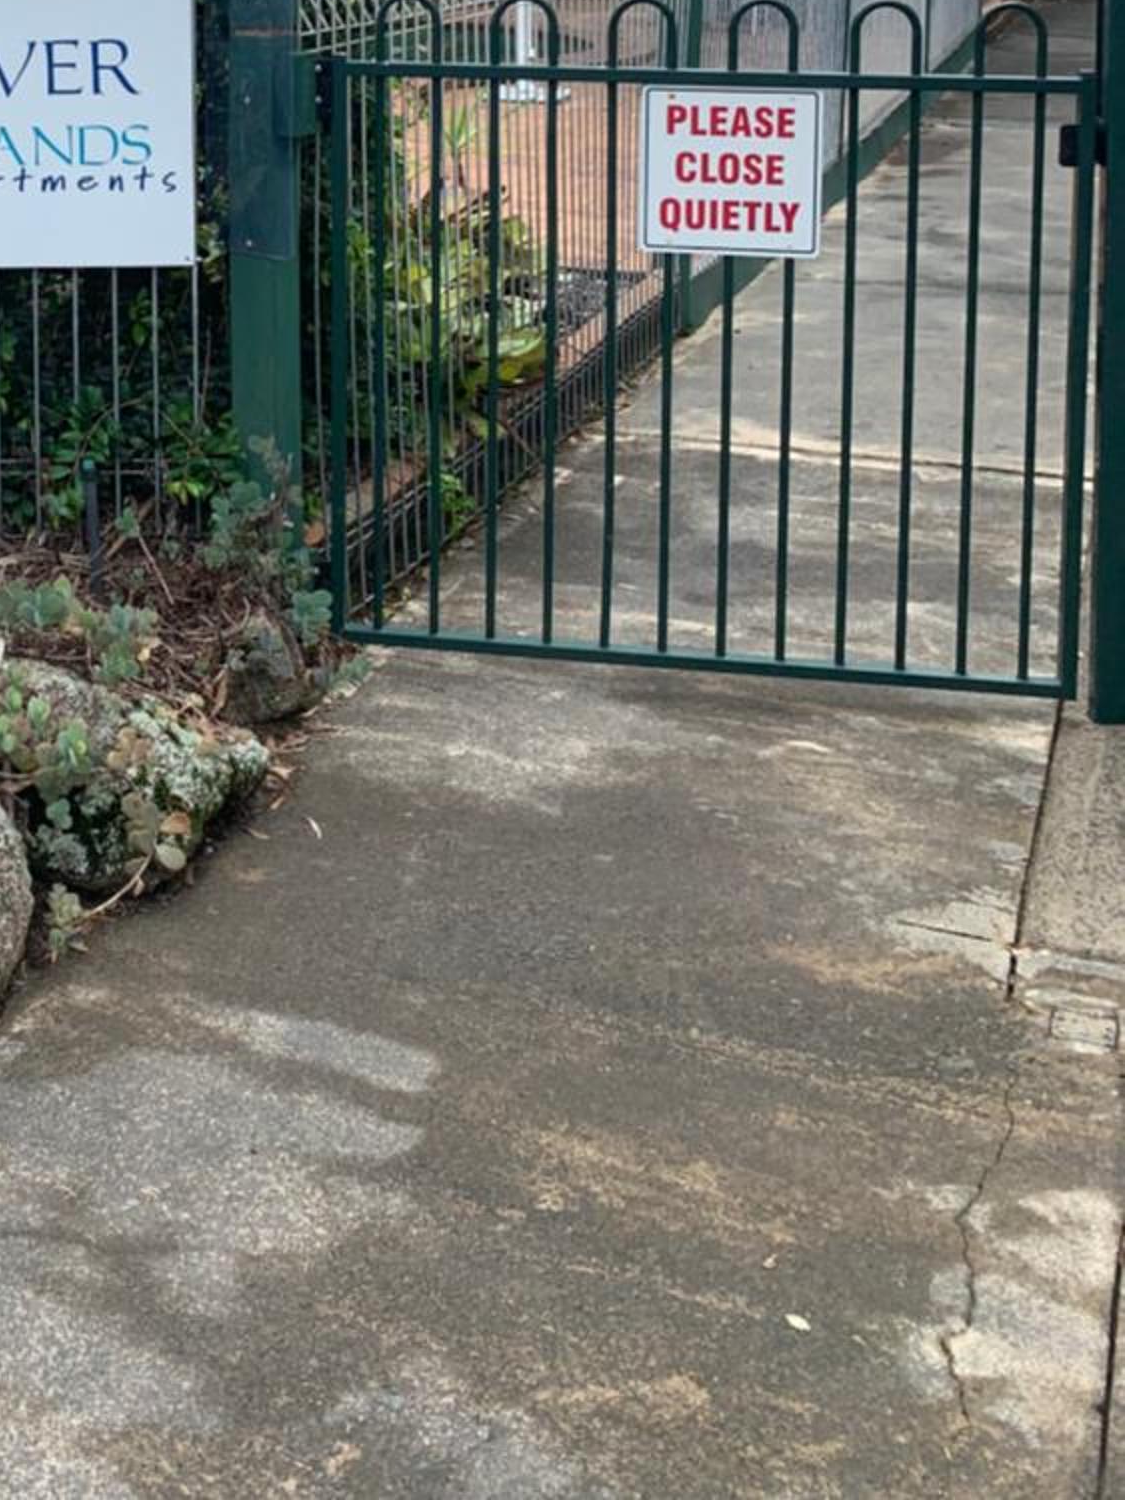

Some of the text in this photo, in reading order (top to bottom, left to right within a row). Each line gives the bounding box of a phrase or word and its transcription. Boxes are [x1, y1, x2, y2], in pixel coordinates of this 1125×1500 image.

[666, 104, 796, 139] PLEASE
[675, 151, 785, 186] CLOSE
[658, 197, 801, 234] QUIETLY
